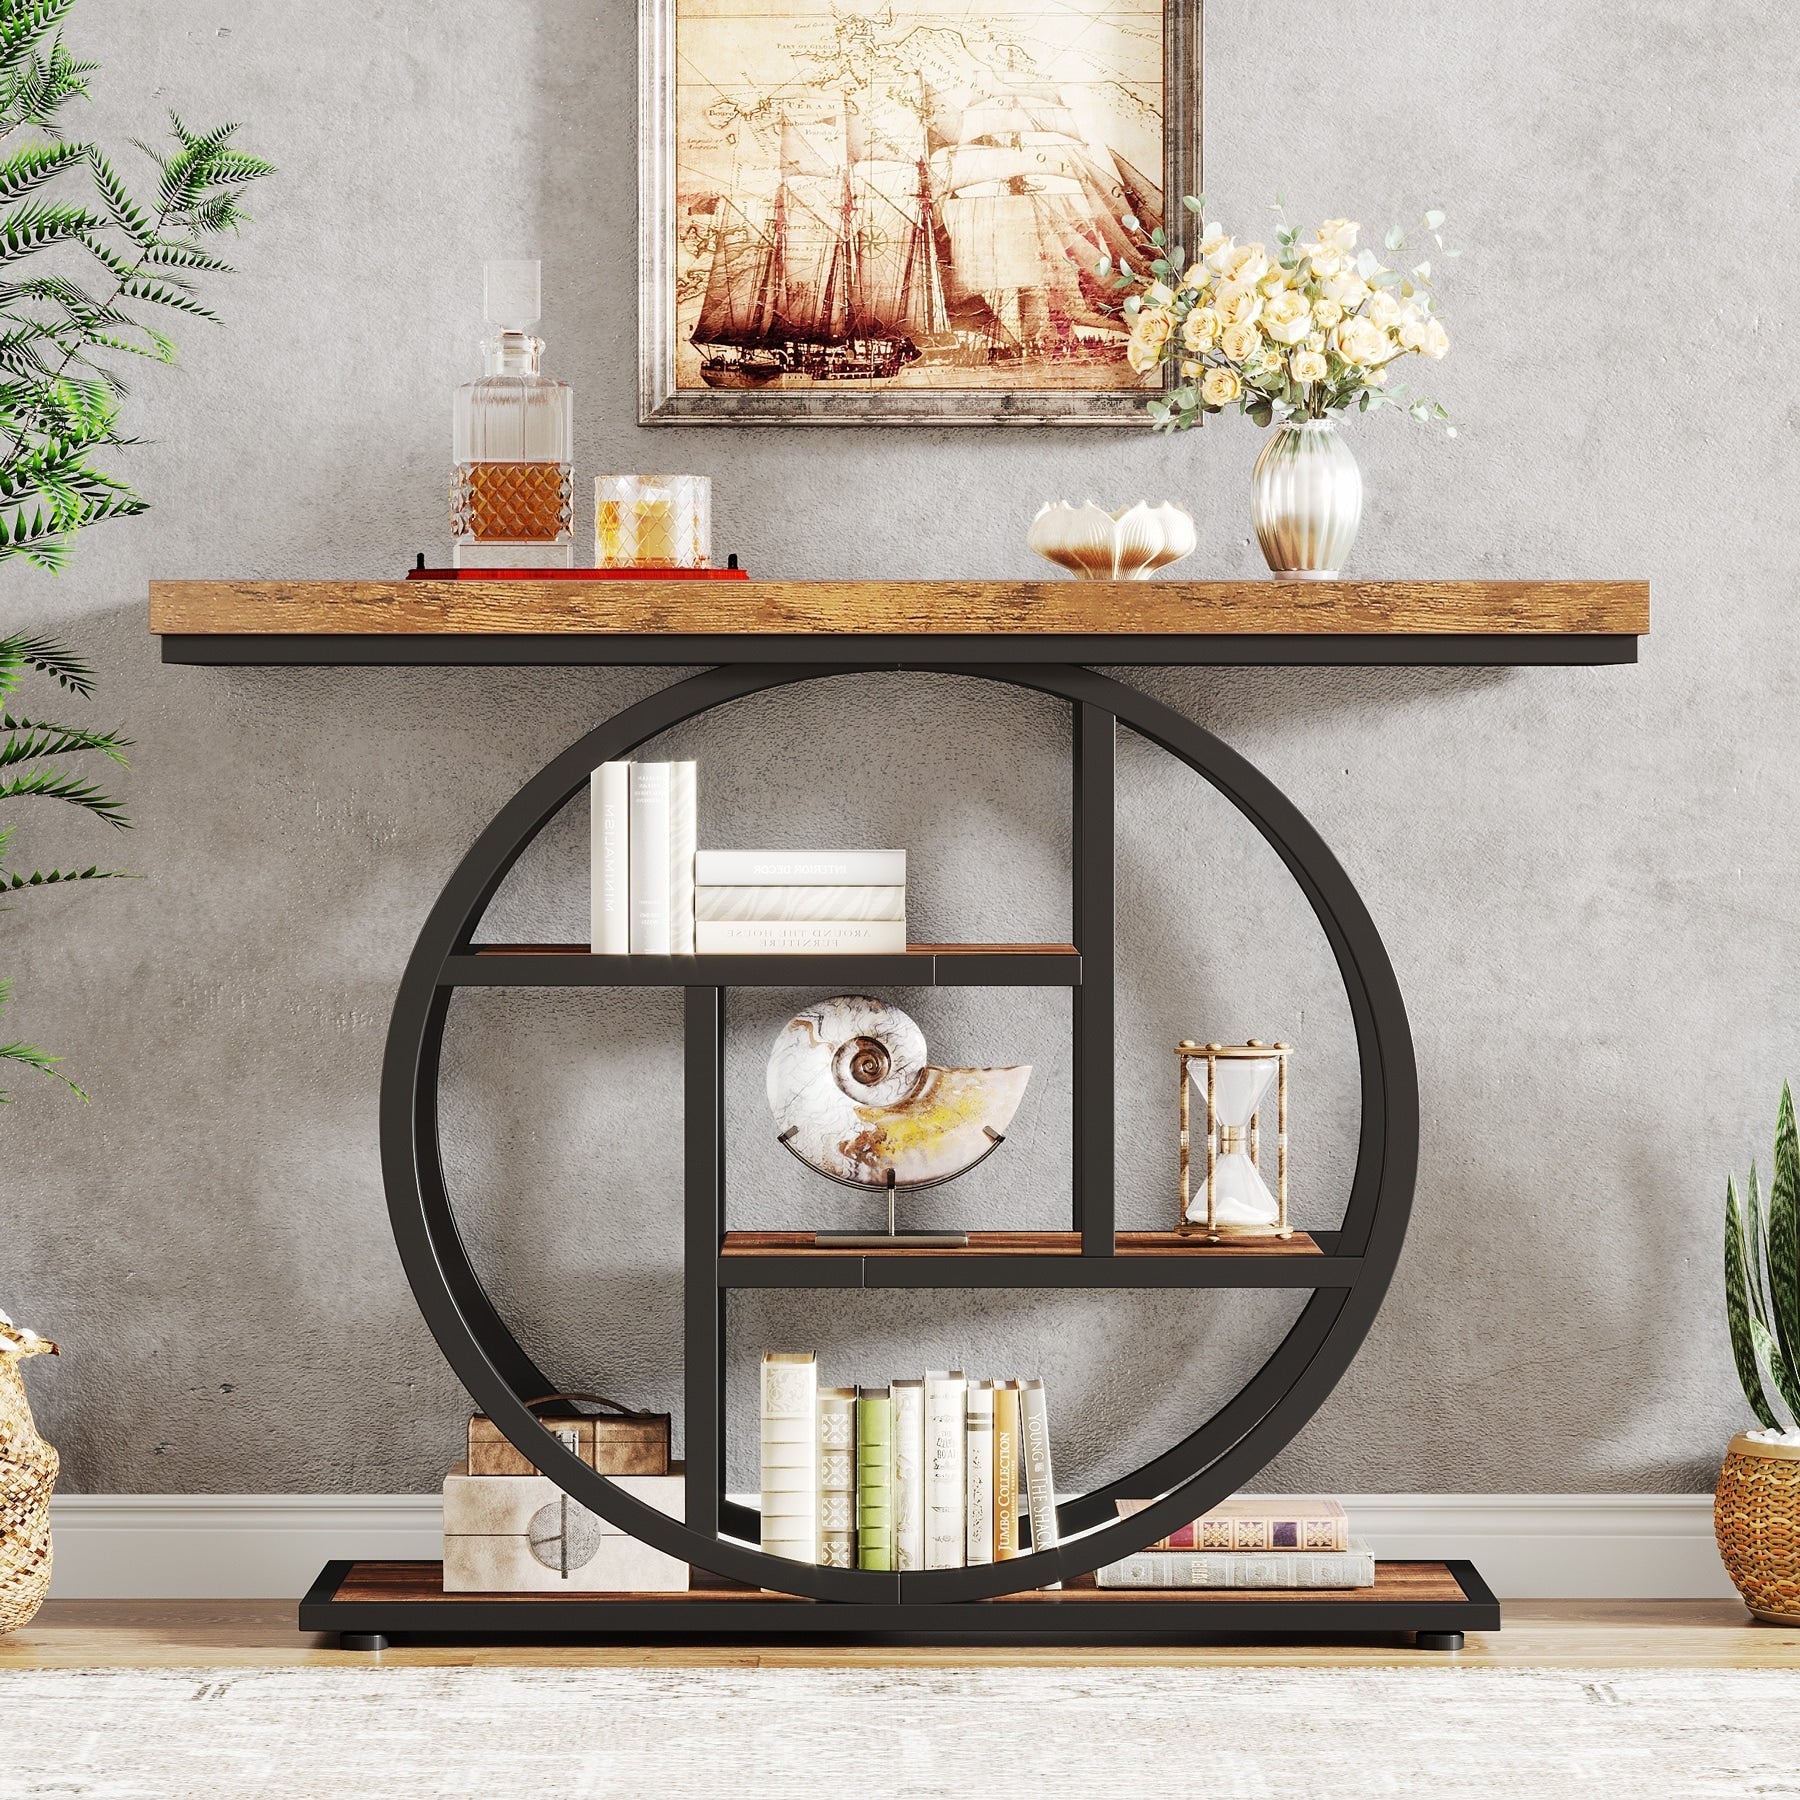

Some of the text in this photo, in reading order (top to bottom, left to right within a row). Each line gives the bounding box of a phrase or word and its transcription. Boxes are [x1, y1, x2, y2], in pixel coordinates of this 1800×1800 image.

[998, 1431, 1013, 1551] JUMBO COLLECTION
[1028, 1412, 1053, 1551] YOUNG THE SHACK
